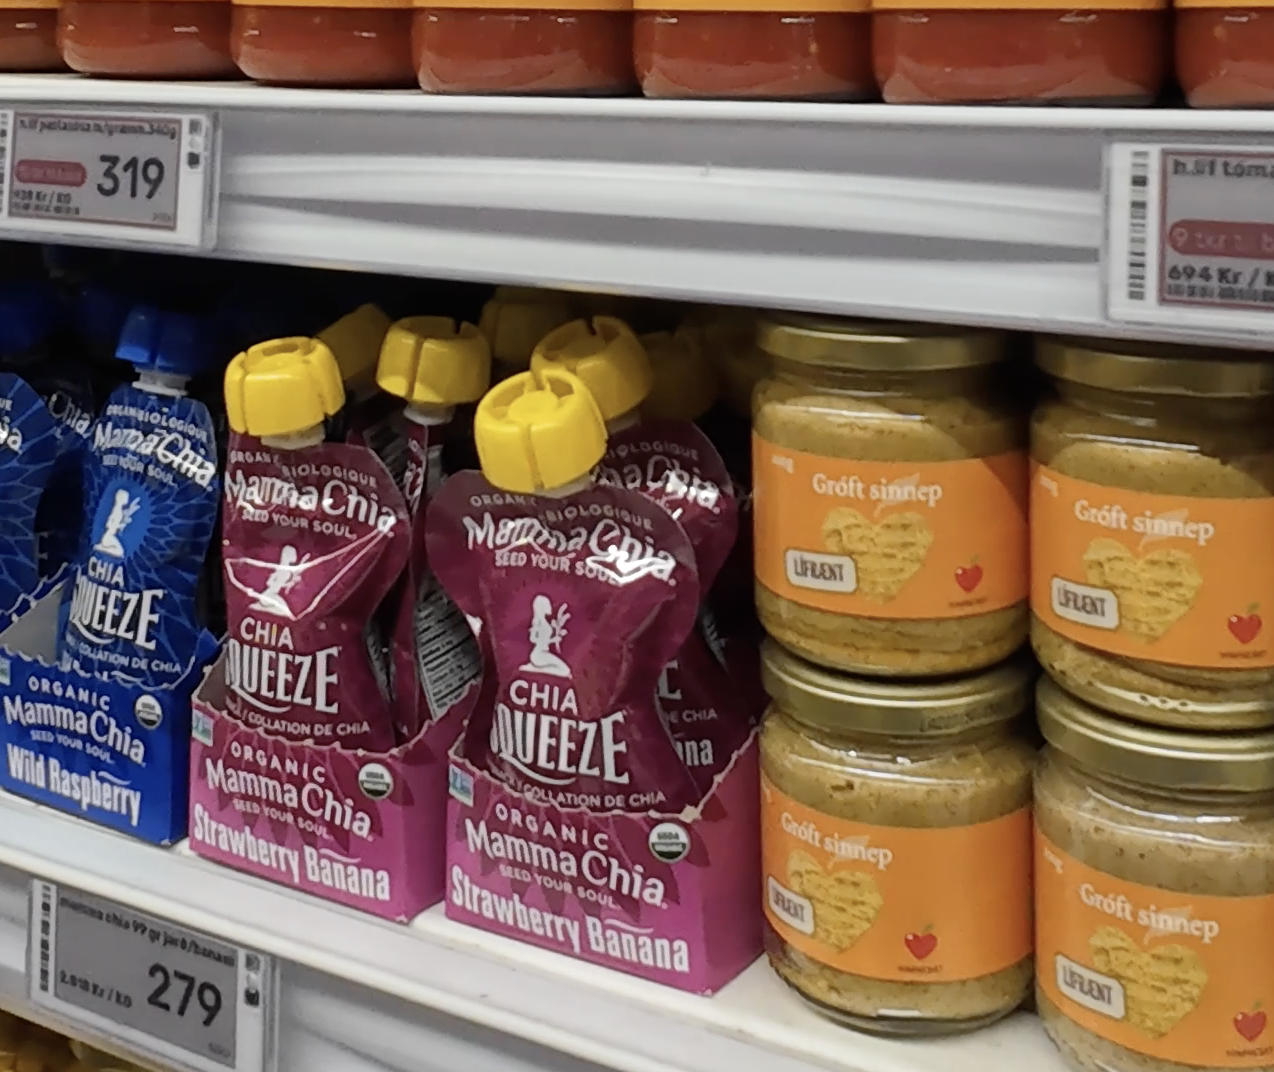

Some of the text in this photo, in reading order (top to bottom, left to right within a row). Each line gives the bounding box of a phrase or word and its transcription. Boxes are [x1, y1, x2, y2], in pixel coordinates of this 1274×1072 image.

[96, 154, 165, 200] 319
[1167, 263, 1213, 283] 694
[1217, 266, 1243, 286] Kr
[811, 472, 944, 508] Gróft sinnep
[541, 502, 655, 532] BIOLOGIQUE
[1074, 499, 1215, 547] Gróft sinnep
[87, 555, 126, 588] CHIA
[530, 552, 572, 574] YOUR
[792, 554, 845, 583] LÍFRÆNT
[239, 616, 295, 651] CHIA
[28, 675, 111, 712] ORGANIC
[508, 679, 579, 717] CHIA
[313, 723, 333, 737] DE
[336, 720, 371, 735] CHIA
[682, 708, 719, 724] CHIA
[230, 740, 326, 784] ORGANIC
[6, 743, 142, 828] Wild Raspberry
[603, 794, 625, 808] DE
[628, 790, 668, 808] CHIA
[495, 802, 610, 852] ORGANIC
[780, 811, 893, 870] Gróft sinnep
[193, 802, 392, 902] Strawberry Banana
[498, 863, 533, 883] SEED
[535, 872, 574, 895] YOUR
[451, 864, 691, 974] Strawberry Banana
[1078, 883, 1220, 945] Gróft sinnep
[146, 961, 223, 1028] 279
